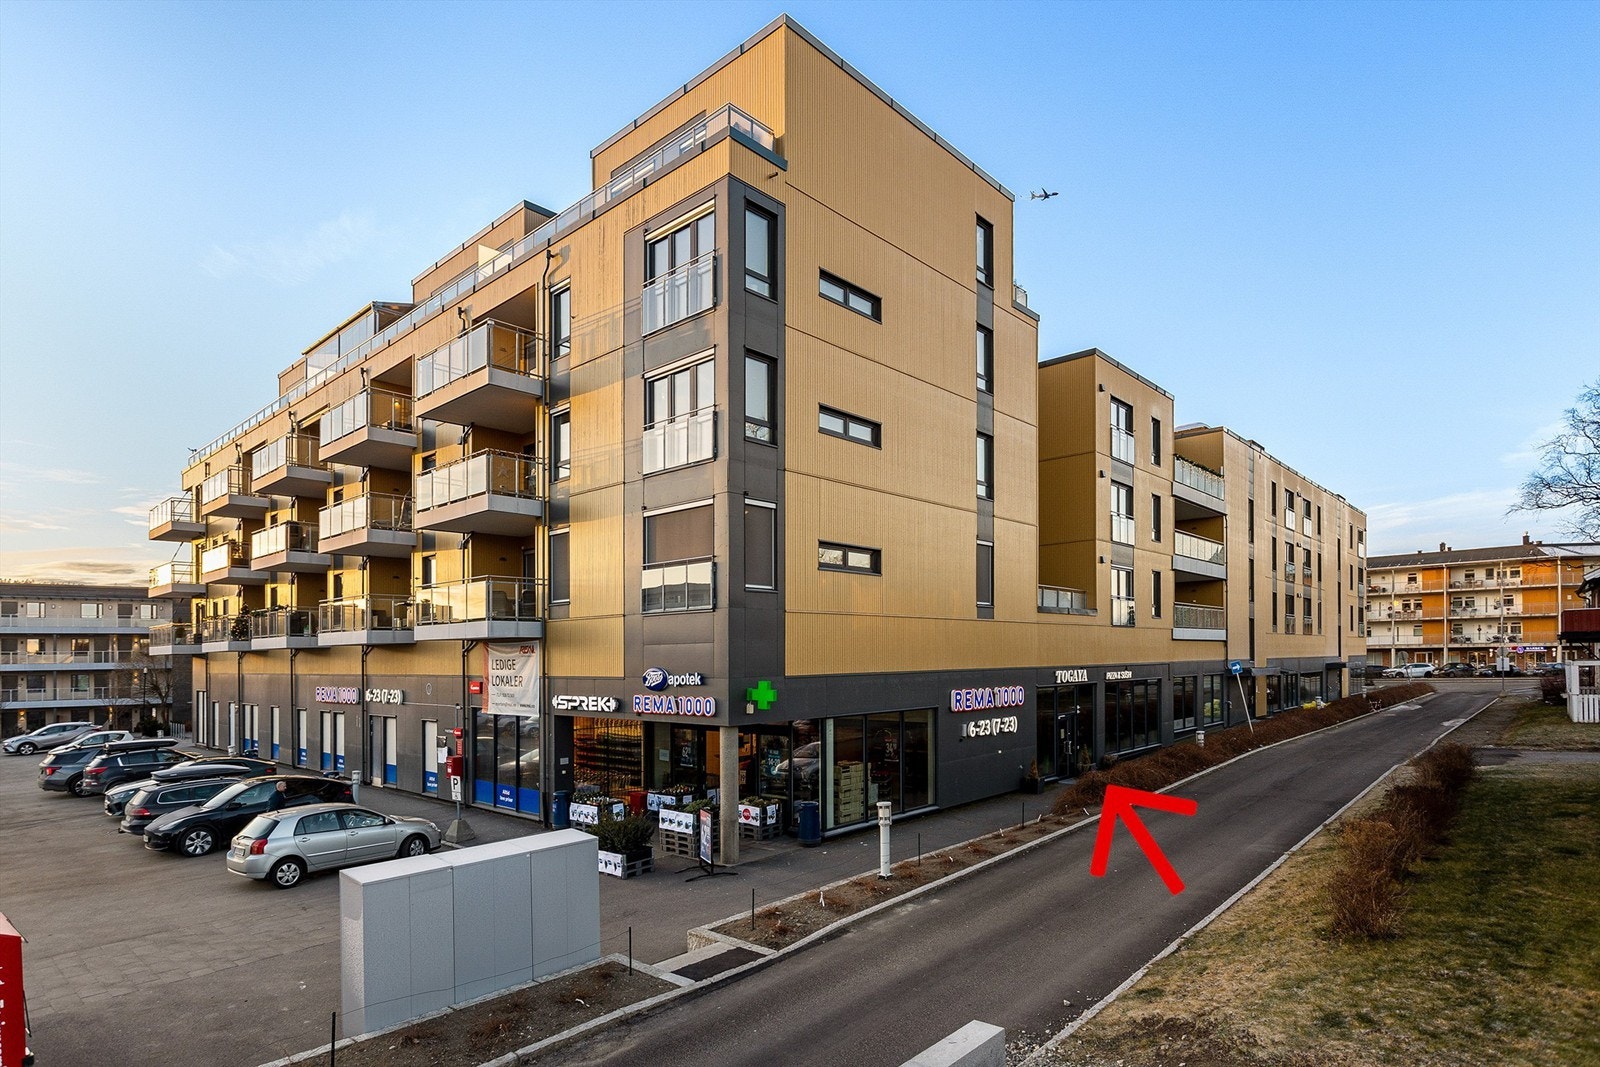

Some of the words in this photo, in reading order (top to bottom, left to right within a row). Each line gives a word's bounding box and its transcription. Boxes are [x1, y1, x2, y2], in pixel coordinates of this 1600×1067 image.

[492, 658, 516, 670] LEDIGE
[492, 675, 523, 688] LOKALER
[668, 672, 702, 688] apotek
[1056, 669, 1088, 684] TOGAYA
[316, 686, 337, 702] REMA
[338, 687, 358, 704] 1000
[366, 688, 381, 703] 6-23
[382, 688, 402, 705] (7-23)
[555, 695, 611, 712] SPREK
[952, 688, 995, 712] REMA
[995, 686, 1024, 708] 1000
[633, 694, 676, 714] REMA
[678, 695, 716, 717] 1000
[968, 719, 991, 738] 6-23
[992, 716, 1018, 736] (7-23)
[453, 778, 458, 790] P
